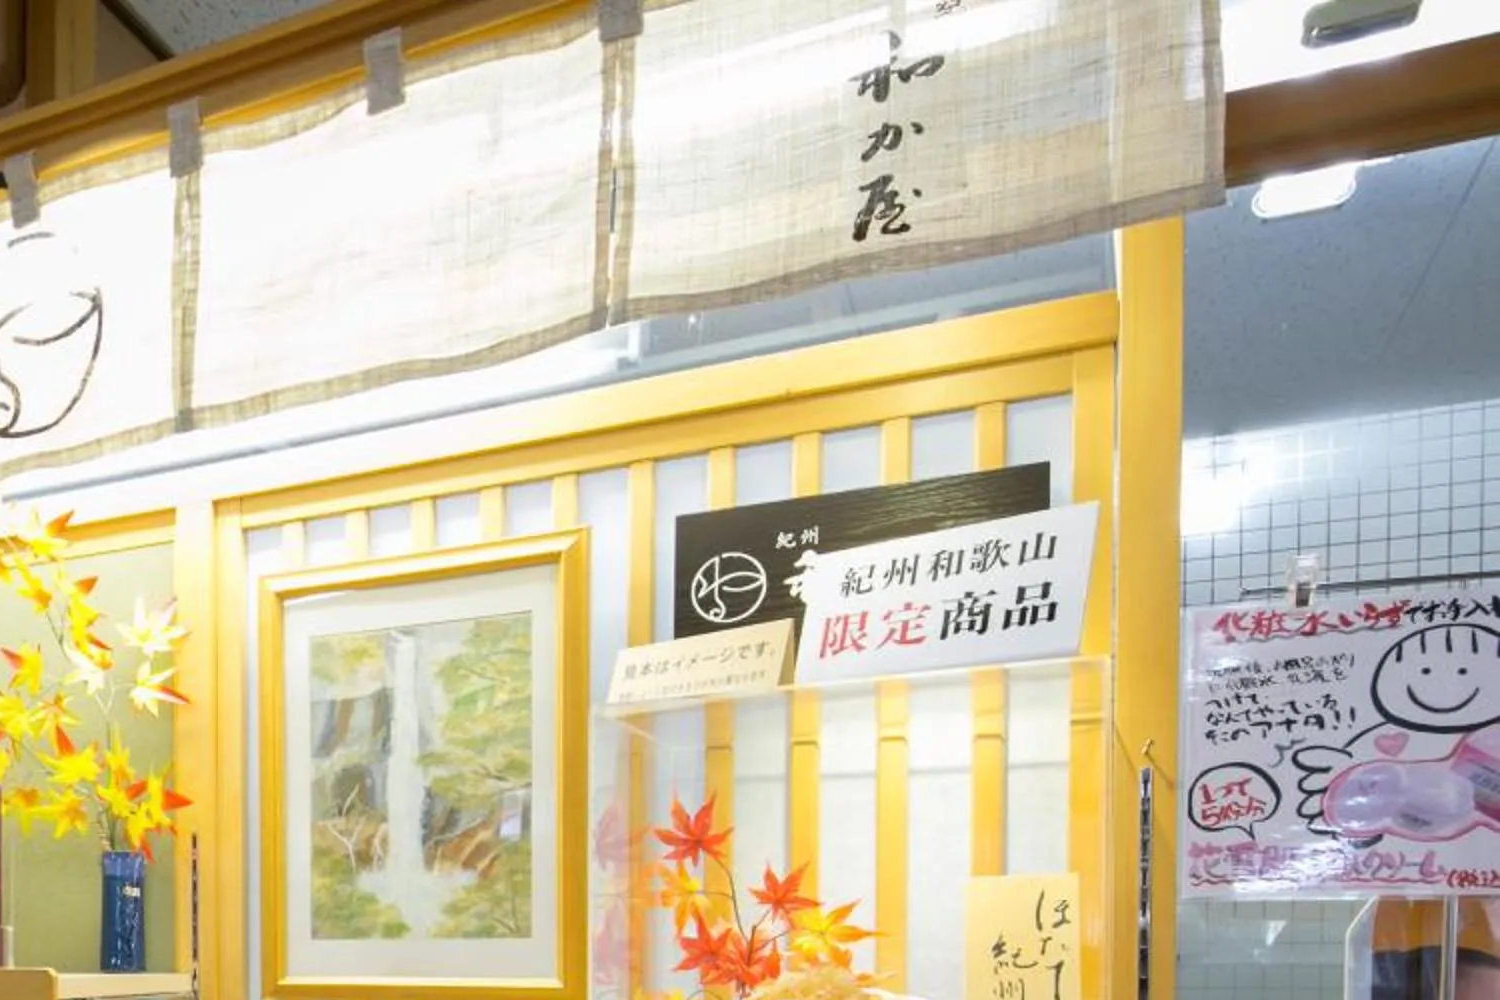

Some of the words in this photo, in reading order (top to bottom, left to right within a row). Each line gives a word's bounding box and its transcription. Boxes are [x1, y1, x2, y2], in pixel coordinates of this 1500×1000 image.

[775, 525, 820, 549] 紀州
[840, 532, 1059, 598] 紀州和歌山
[818, 581, 1059, 659] 限定商品
